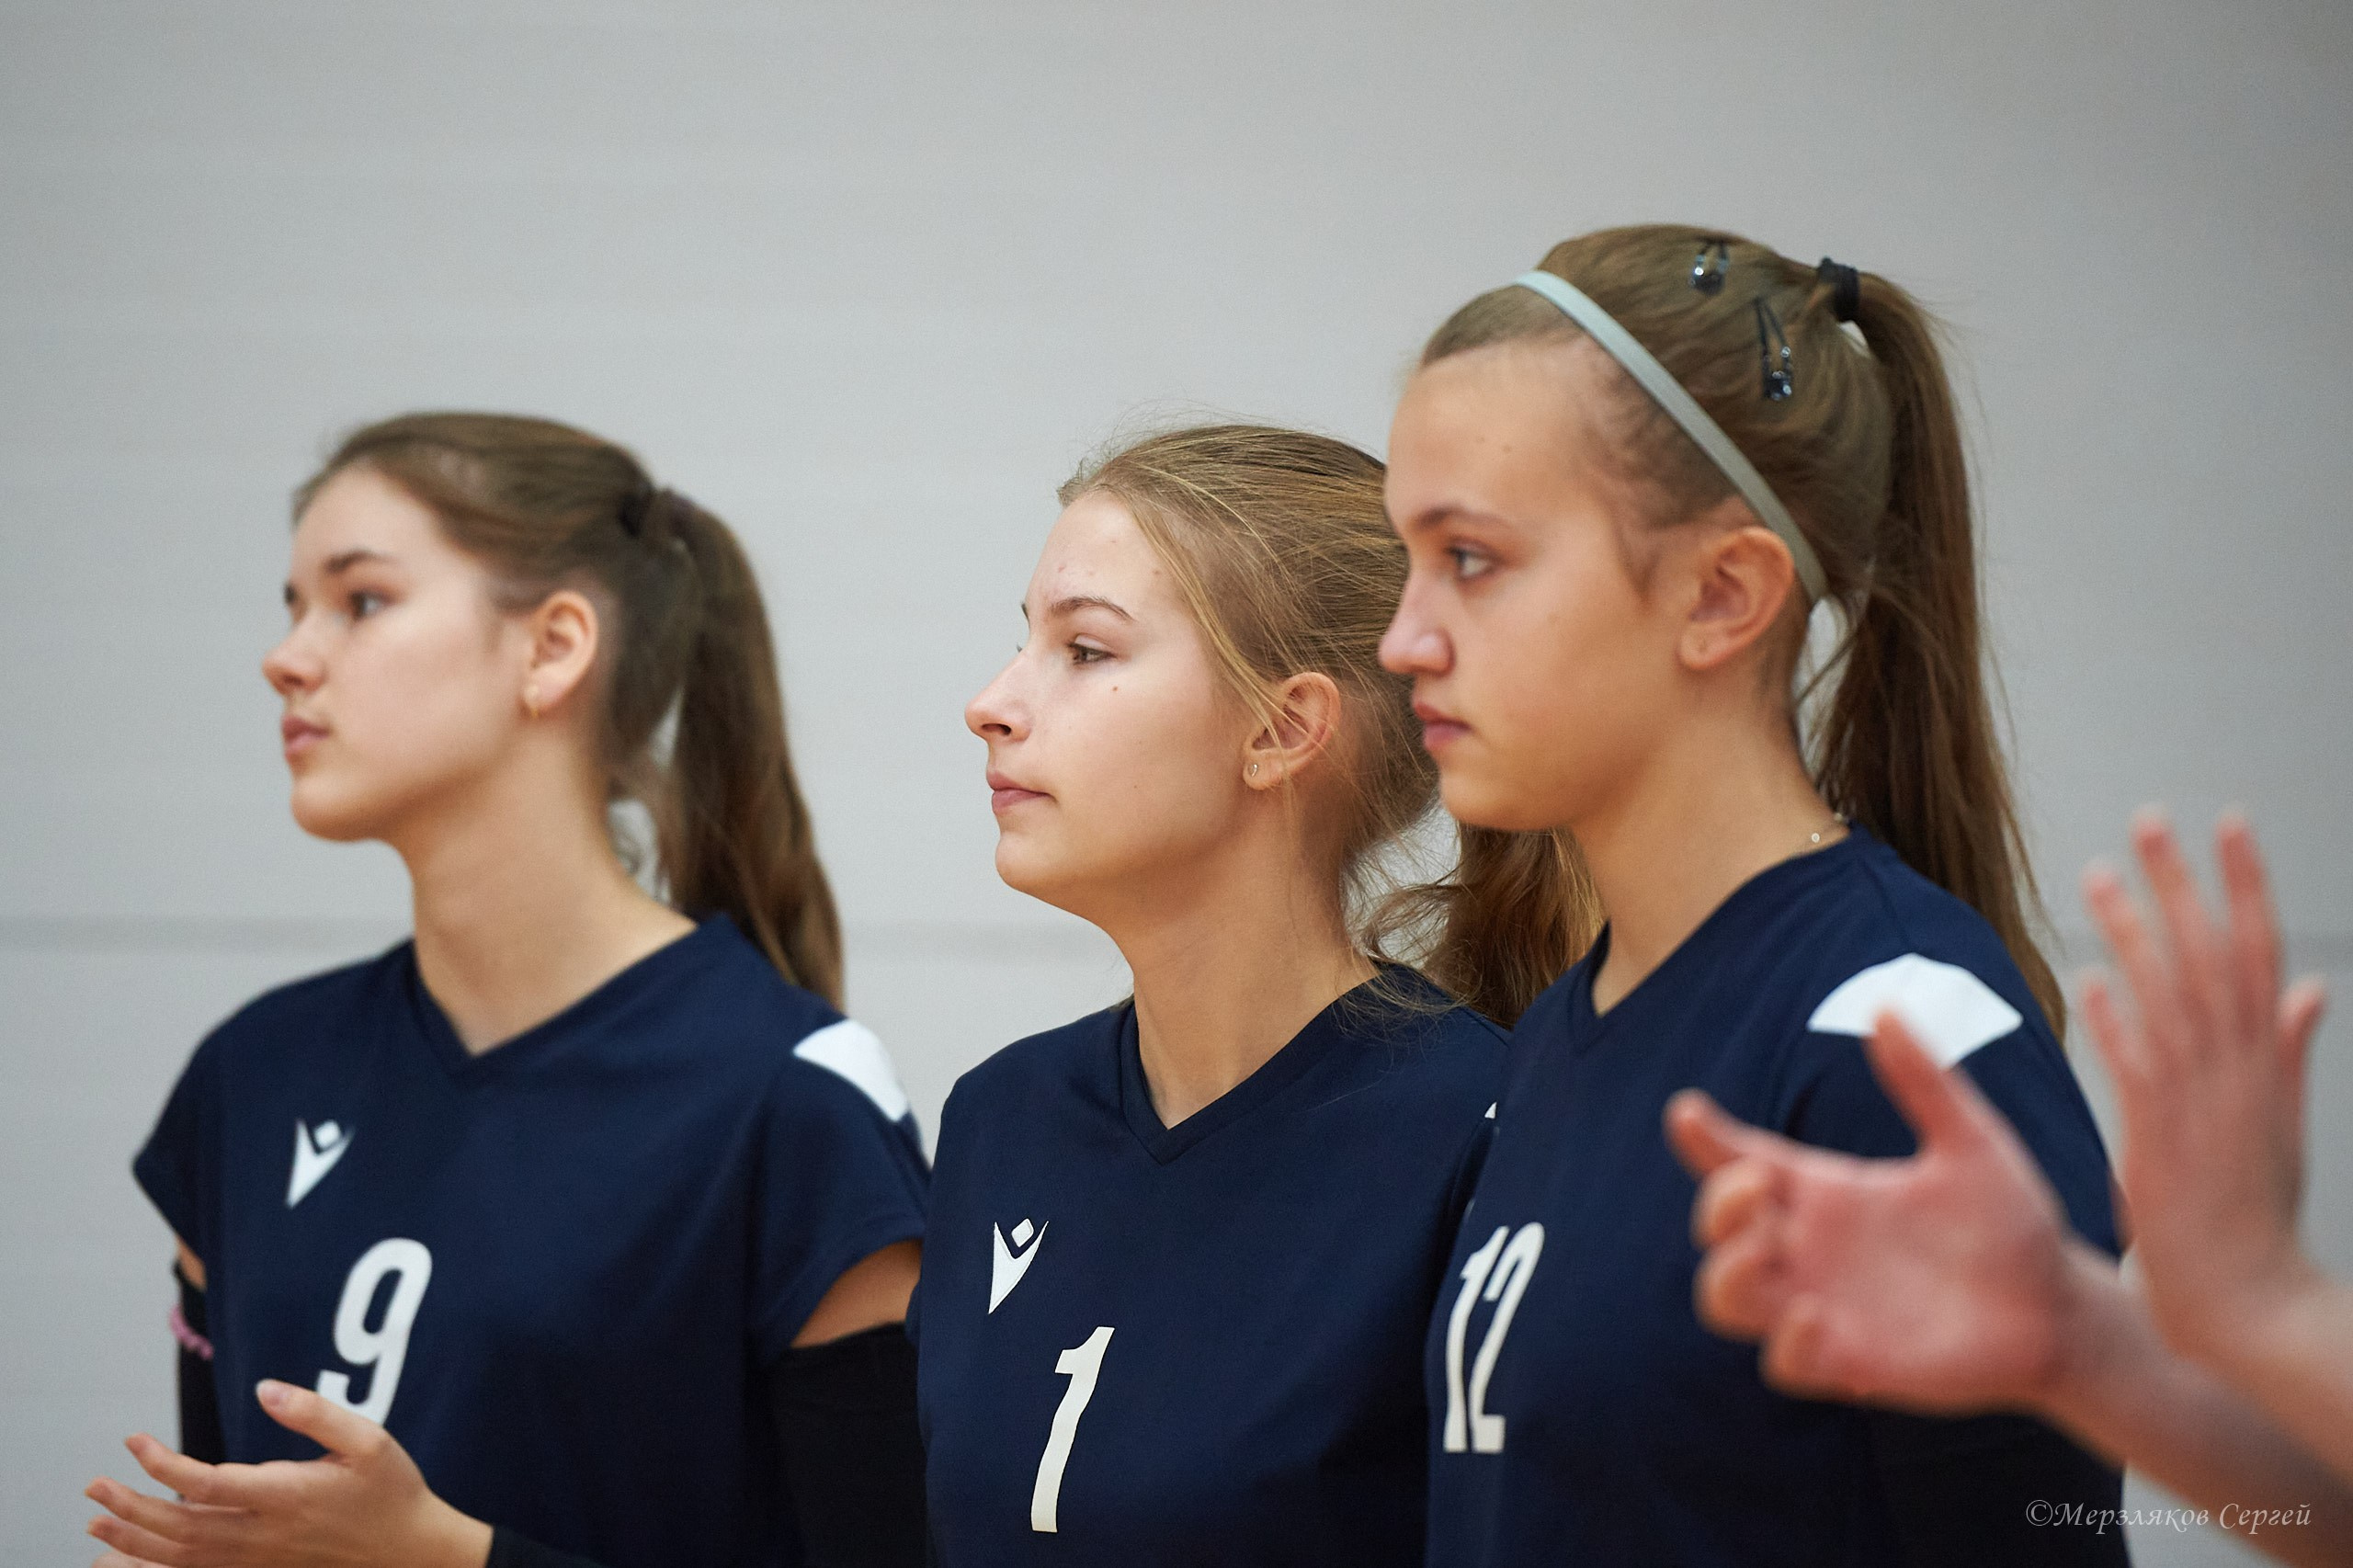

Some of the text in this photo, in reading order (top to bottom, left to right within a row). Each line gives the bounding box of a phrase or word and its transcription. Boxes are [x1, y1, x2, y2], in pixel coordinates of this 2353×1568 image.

[317, 1238, 433, 1426] 9
[1030, 1326, 1115, 1533] 1
[1443, 1221, 1545, 1453] 12
